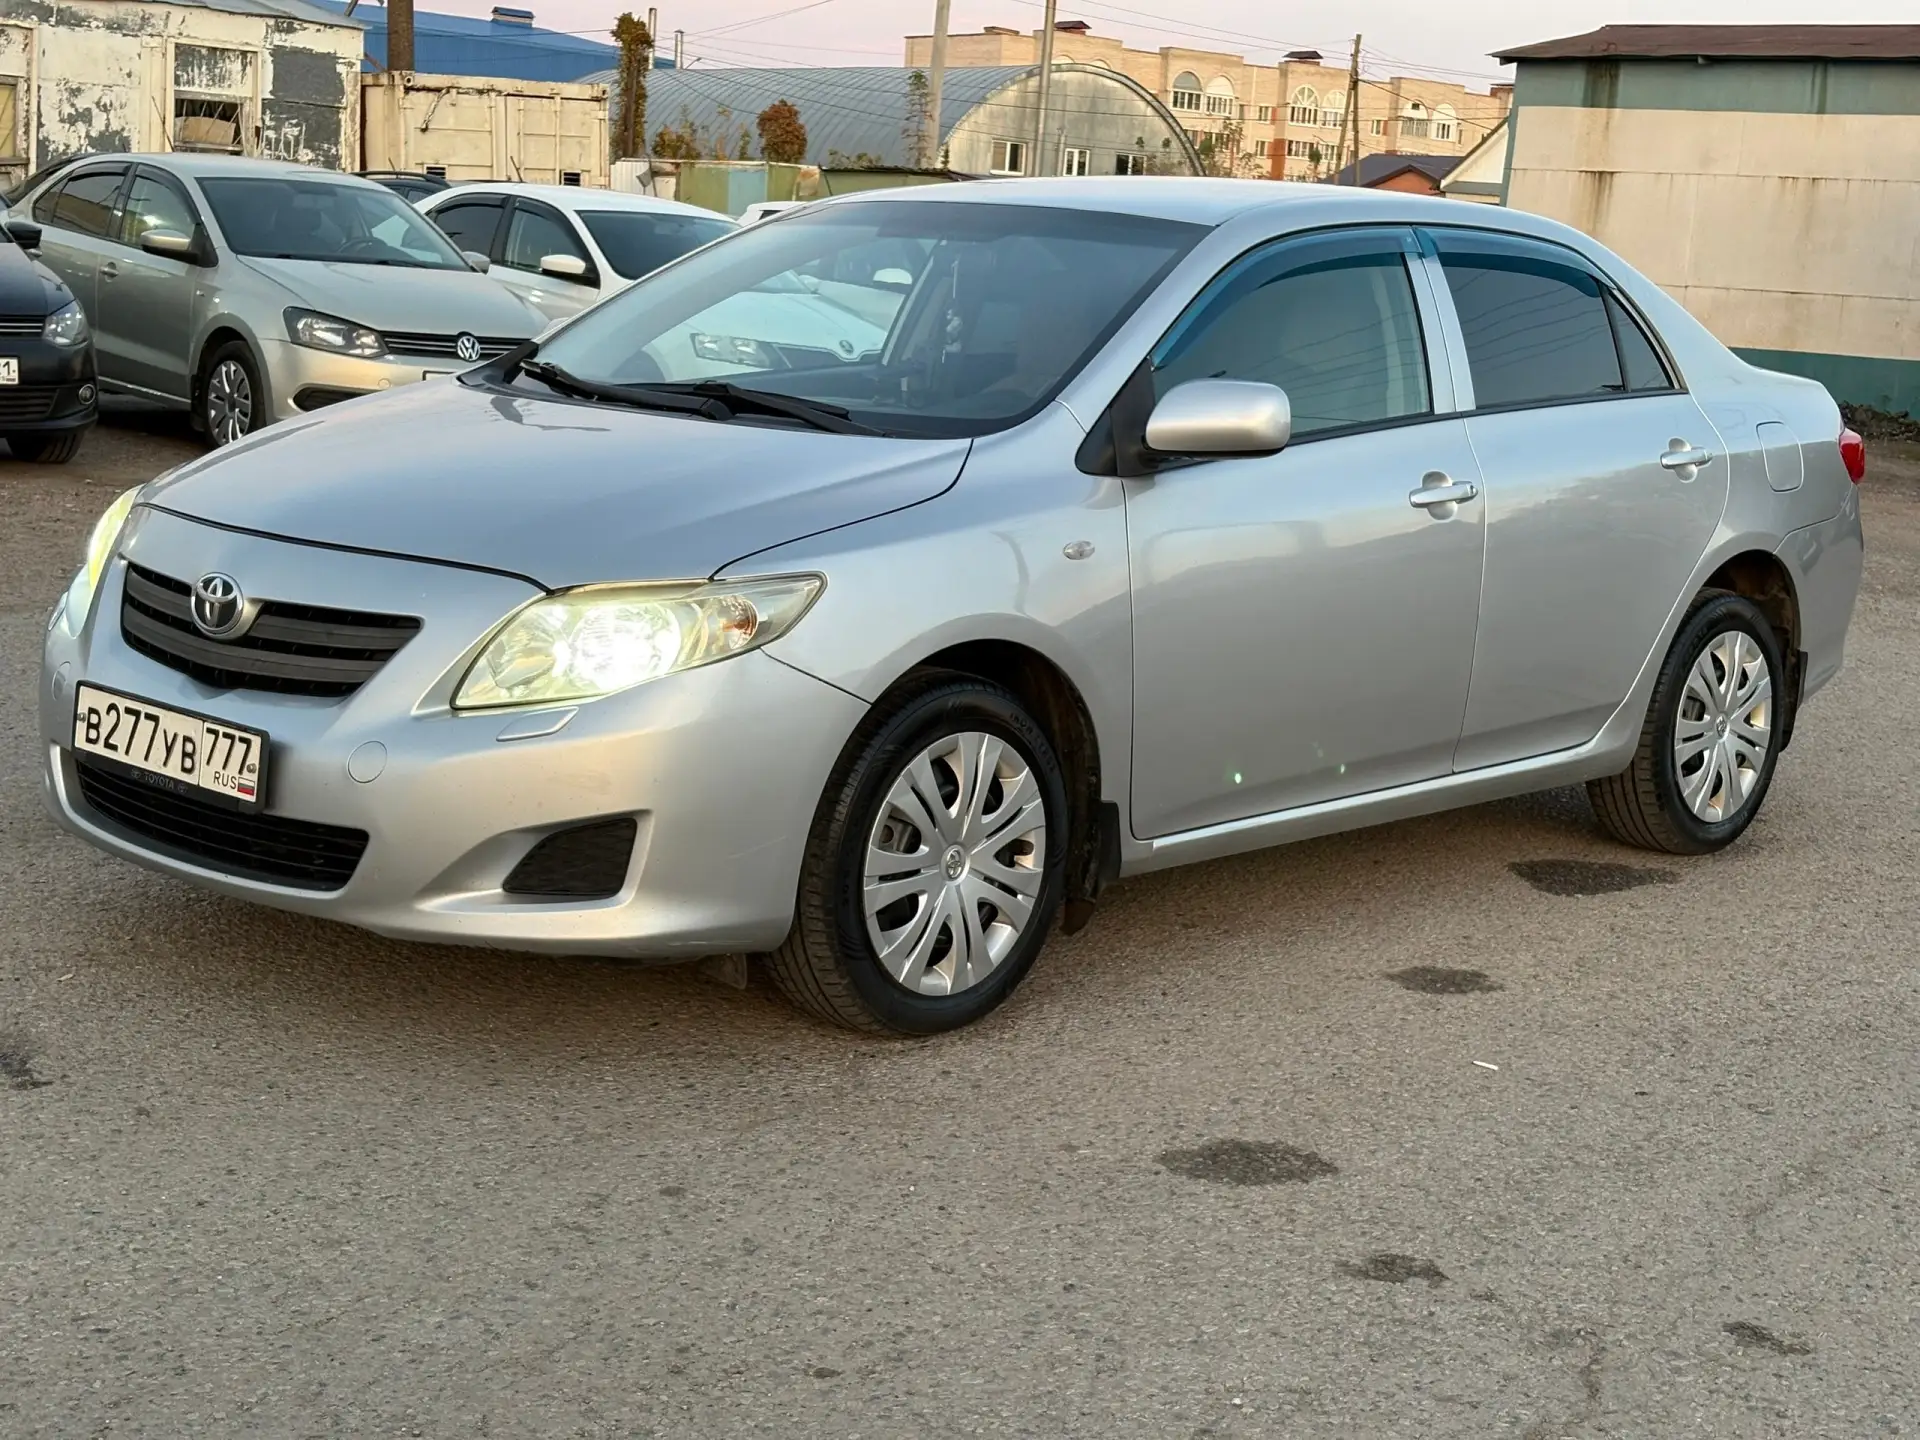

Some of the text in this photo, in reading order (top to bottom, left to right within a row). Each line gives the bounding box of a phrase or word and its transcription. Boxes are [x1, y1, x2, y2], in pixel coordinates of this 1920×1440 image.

[85, 702, 253, 775] В277УВ 777
[144, 771, 175, 790] TOYOTA
[213, 770, 237, 790] RUS
